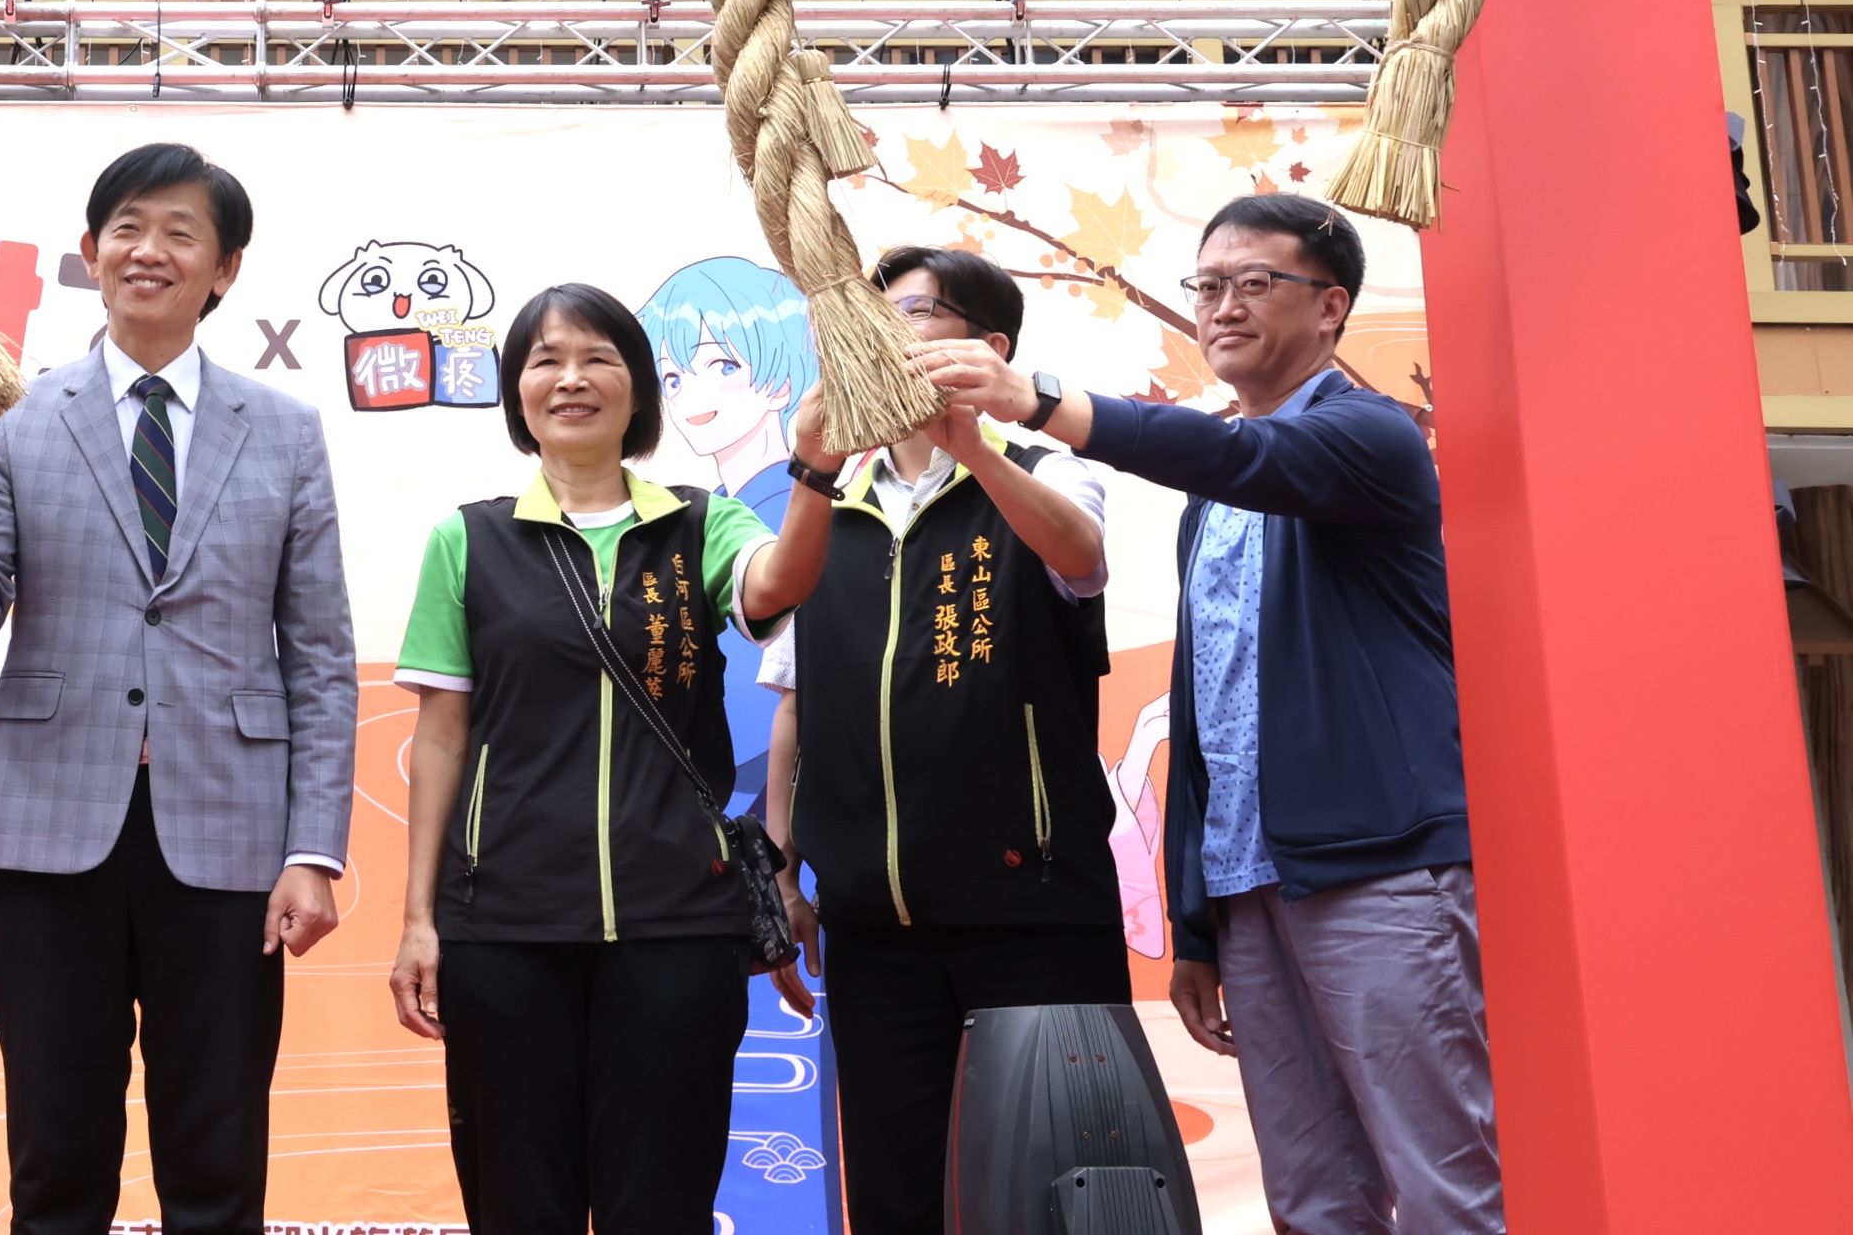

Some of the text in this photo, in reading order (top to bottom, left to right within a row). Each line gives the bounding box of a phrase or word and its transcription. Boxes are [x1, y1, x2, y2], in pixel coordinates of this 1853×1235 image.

[416, 311, 458, 326] WEI
[441, 328, 493, 345] TENG
[354, 345, 484, 397] 微疼
[642, 571, 664, 604] 區長
[970, 535, 993, 664] 東山區公所
[671, 553, 699, 690] 白河區公所
[934, 552, 961, 688] 區長 張政郎
